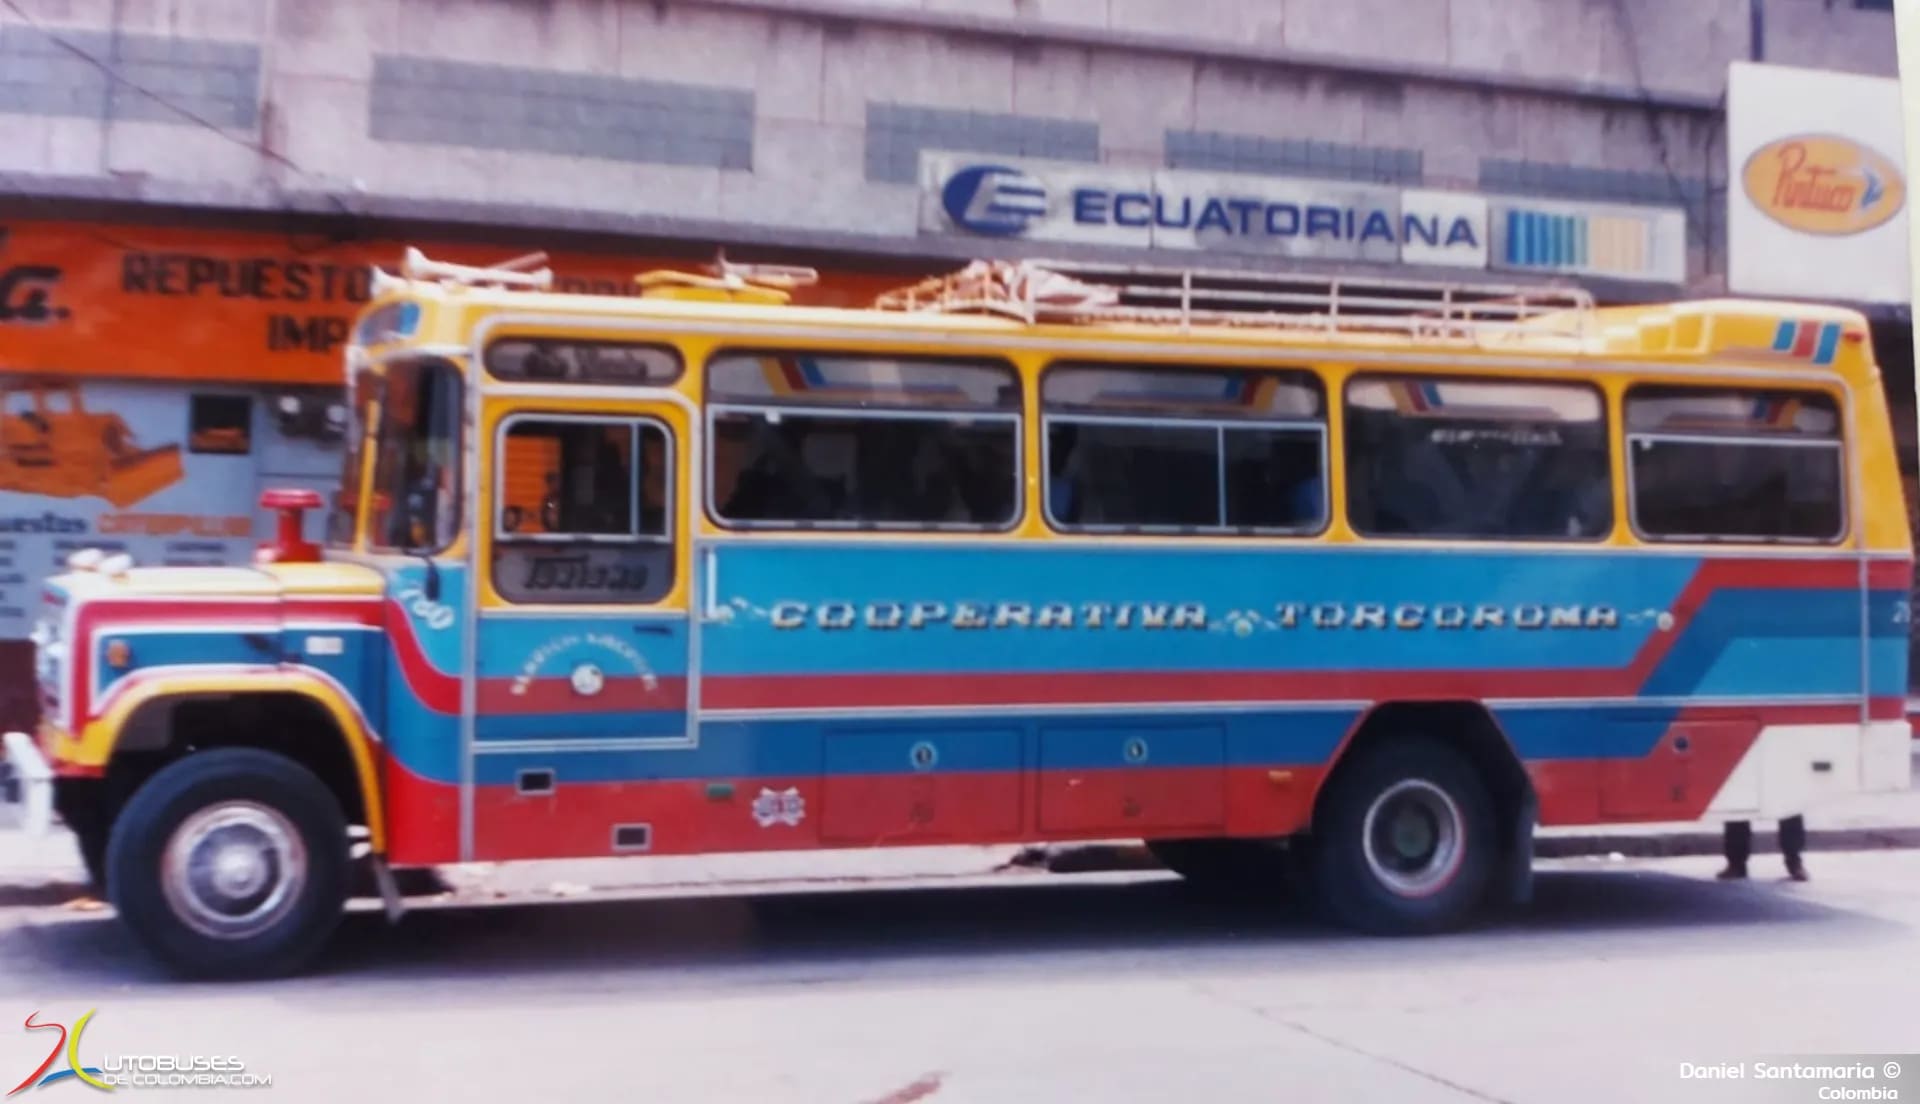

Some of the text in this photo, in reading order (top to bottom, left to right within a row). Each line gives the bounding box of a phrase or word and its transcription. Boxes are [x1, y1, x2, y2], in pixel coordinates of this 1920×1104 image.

[1073, 188, 1478, 248] ECUATORIANA
[770, 600, 1619, 631] COOPERATIVA TORCOROMA
